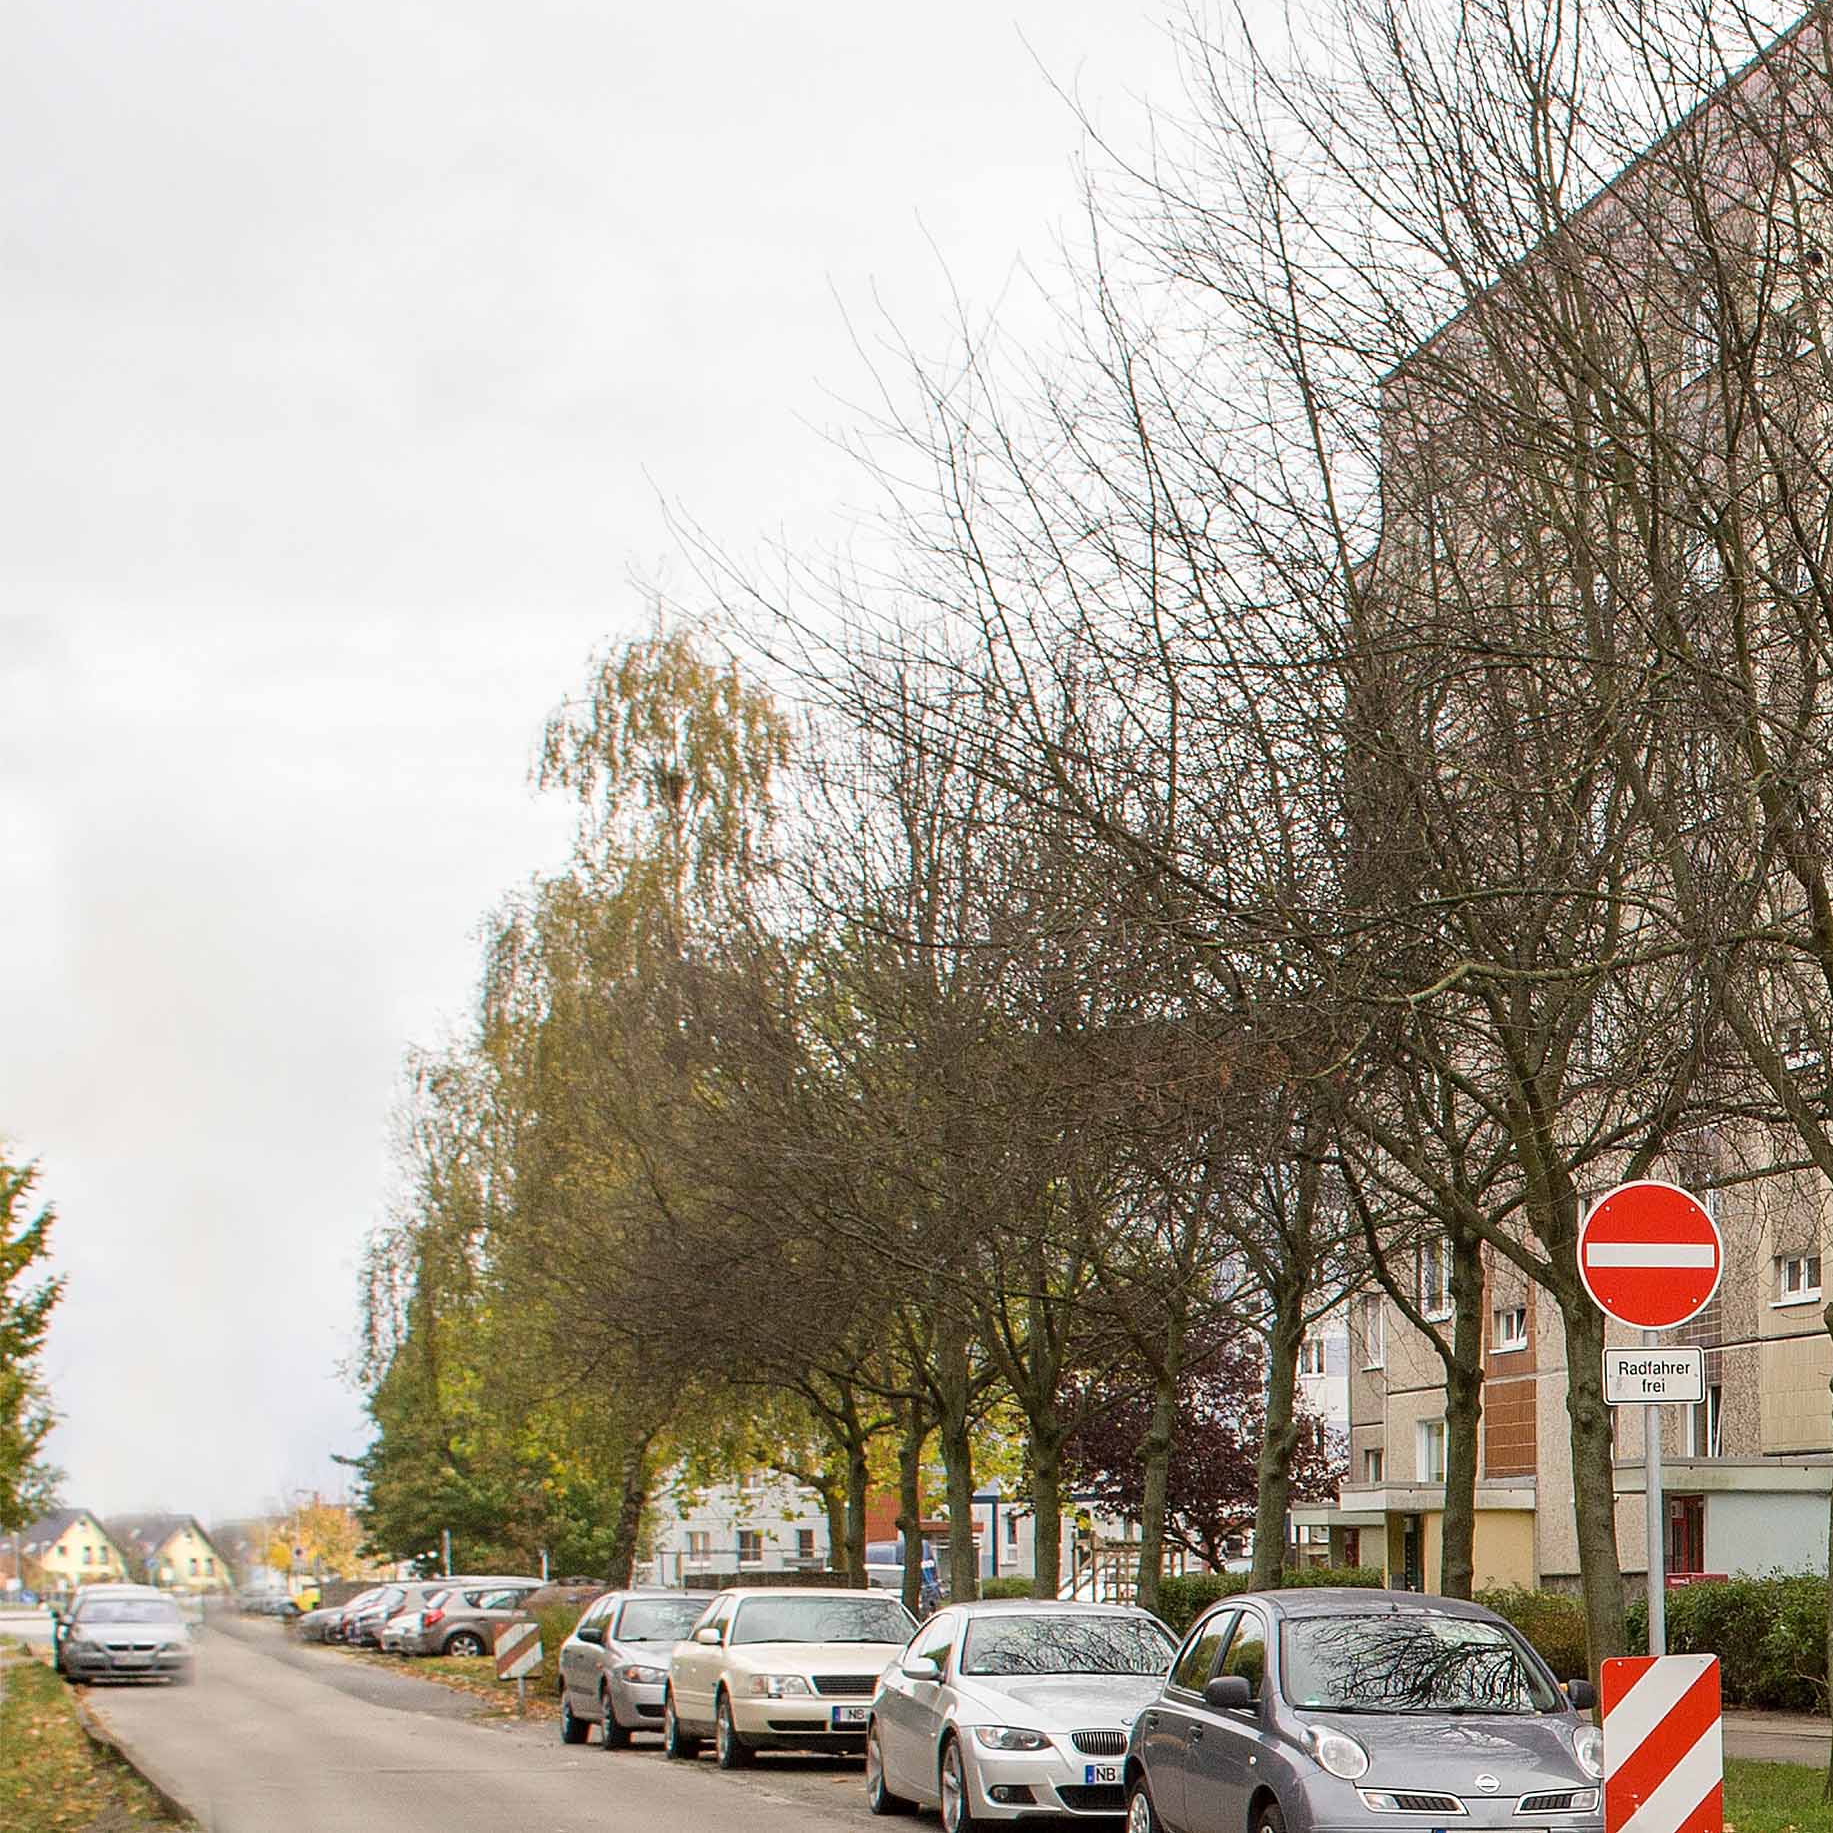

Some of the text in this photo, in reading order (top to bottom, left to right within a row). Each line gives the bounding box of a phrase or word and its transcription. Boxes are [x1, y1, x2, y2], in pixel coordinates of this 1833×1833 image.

[1618, 1360, 1690, 1375] Radfahrer
[1642, 1377, 1665, 1393] frei
[1096, 1767, 1116, 1782] NB
